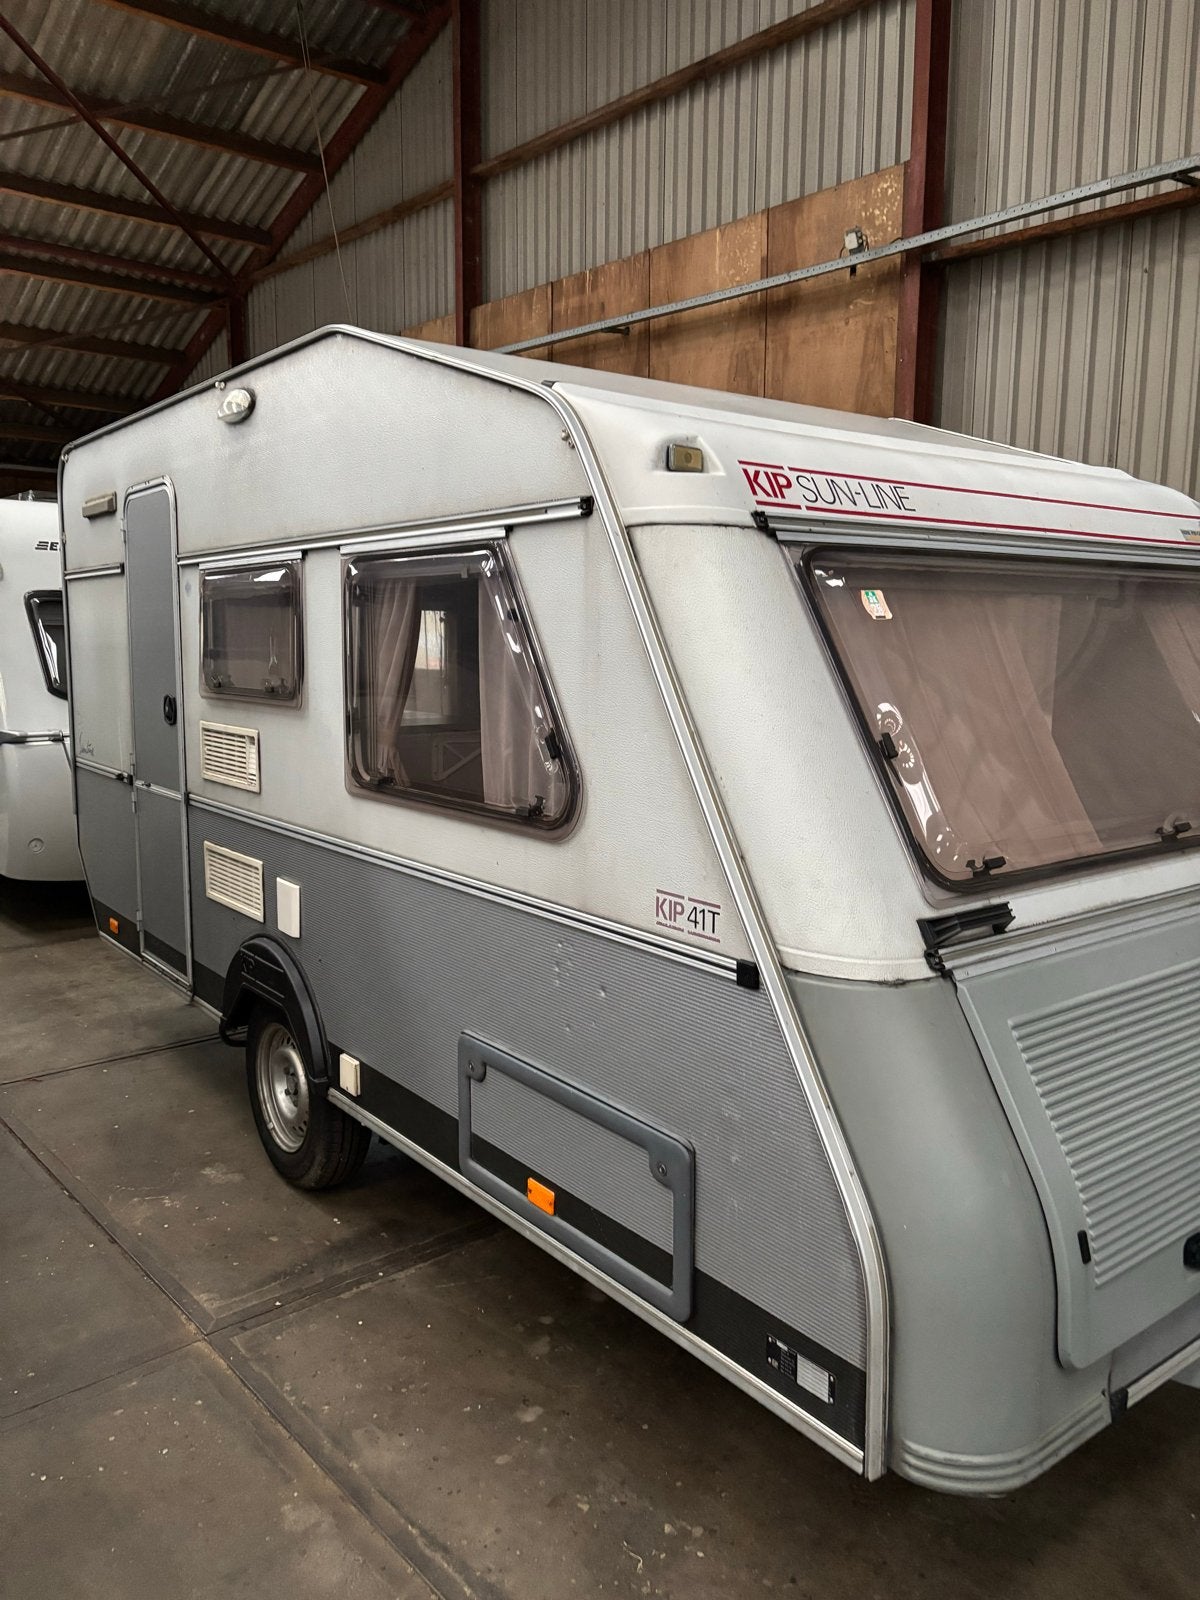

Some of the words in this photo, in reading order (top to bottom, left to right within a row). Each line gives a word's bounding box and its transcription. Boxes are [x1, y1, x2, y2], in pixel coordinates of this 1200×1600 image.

[742, 468, 793, 499] KIP
[796, 475, 916, 512] SUN-LINE
[655, 896, 685, 922] KIP
[687, 906, 721, 934] 41T
